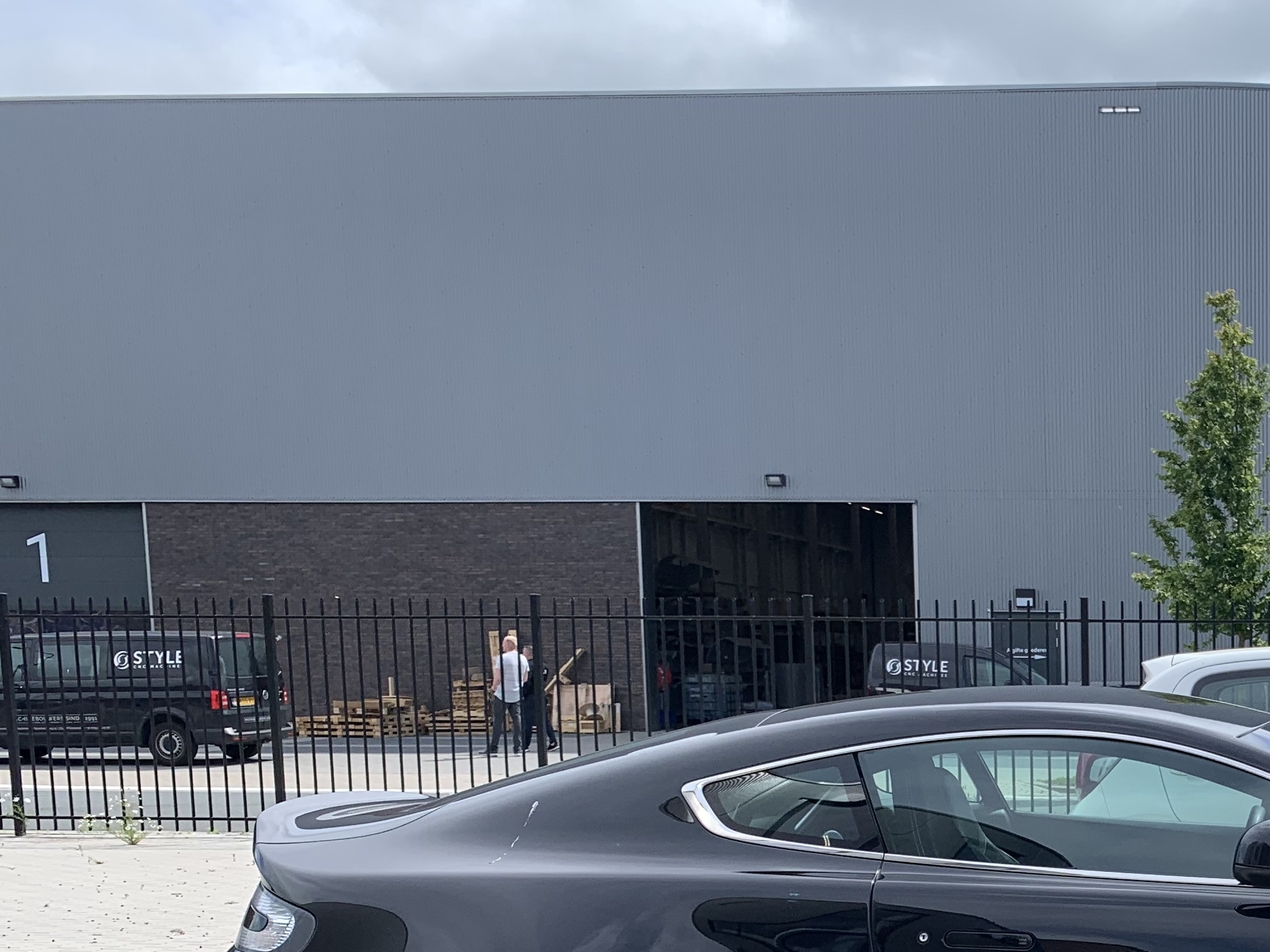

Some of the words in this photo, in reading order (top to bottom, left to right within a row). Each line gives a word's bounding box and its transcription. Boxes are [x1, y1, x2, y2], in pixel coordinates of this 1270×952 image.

[26, 532, 50, 582] 1
[133, 650, 182, 664] STYLE
[904, 659, 949, 673] STYLE
